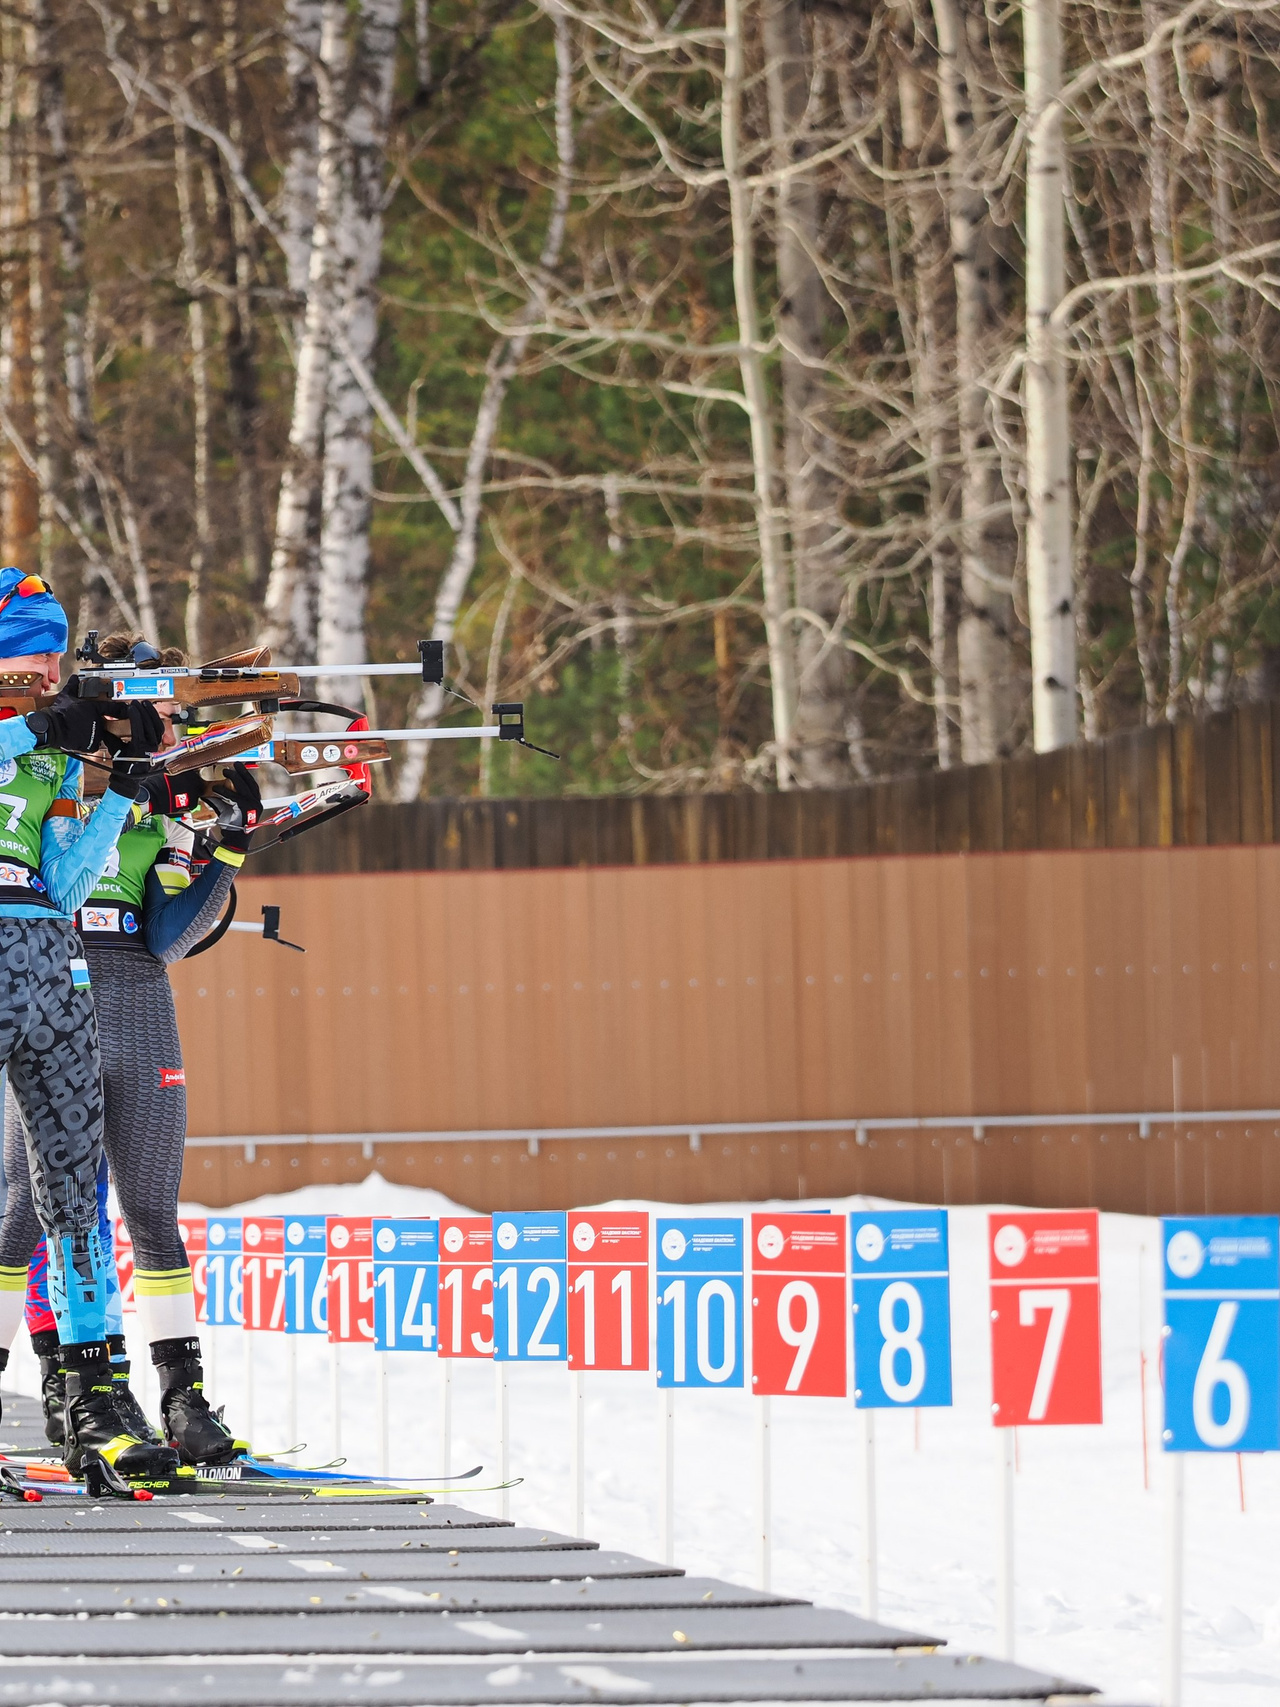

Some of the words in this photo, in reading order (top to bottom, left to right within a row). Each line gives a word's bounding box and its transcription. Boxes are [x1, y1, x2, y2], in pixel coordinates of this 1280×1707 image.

[208, 1255, 243, 1323] 18
[246, 1257, 285, 1328] 17
[288, 1257, 327, 1331] 16
[331, 1261, 374, 1338] 15
[377, 1267, 436, 1348] 14
[444, 1268, 493, 1353] 13
[498, 1266, 560, 1356] 12
[574, 1270, 632, 1365] 11
[663, 1279, 735, 1383] 10
[81, 1347, 101, 1359] 177
[777, 1280, 819, 1391] 9
[878, 1281, 925, 1402] 8
[1019, 1288, 1071, 1420] 7
[1193, 1300, 1250, 1447] 6
[127, 1481, 170, 1489] FISCHER
